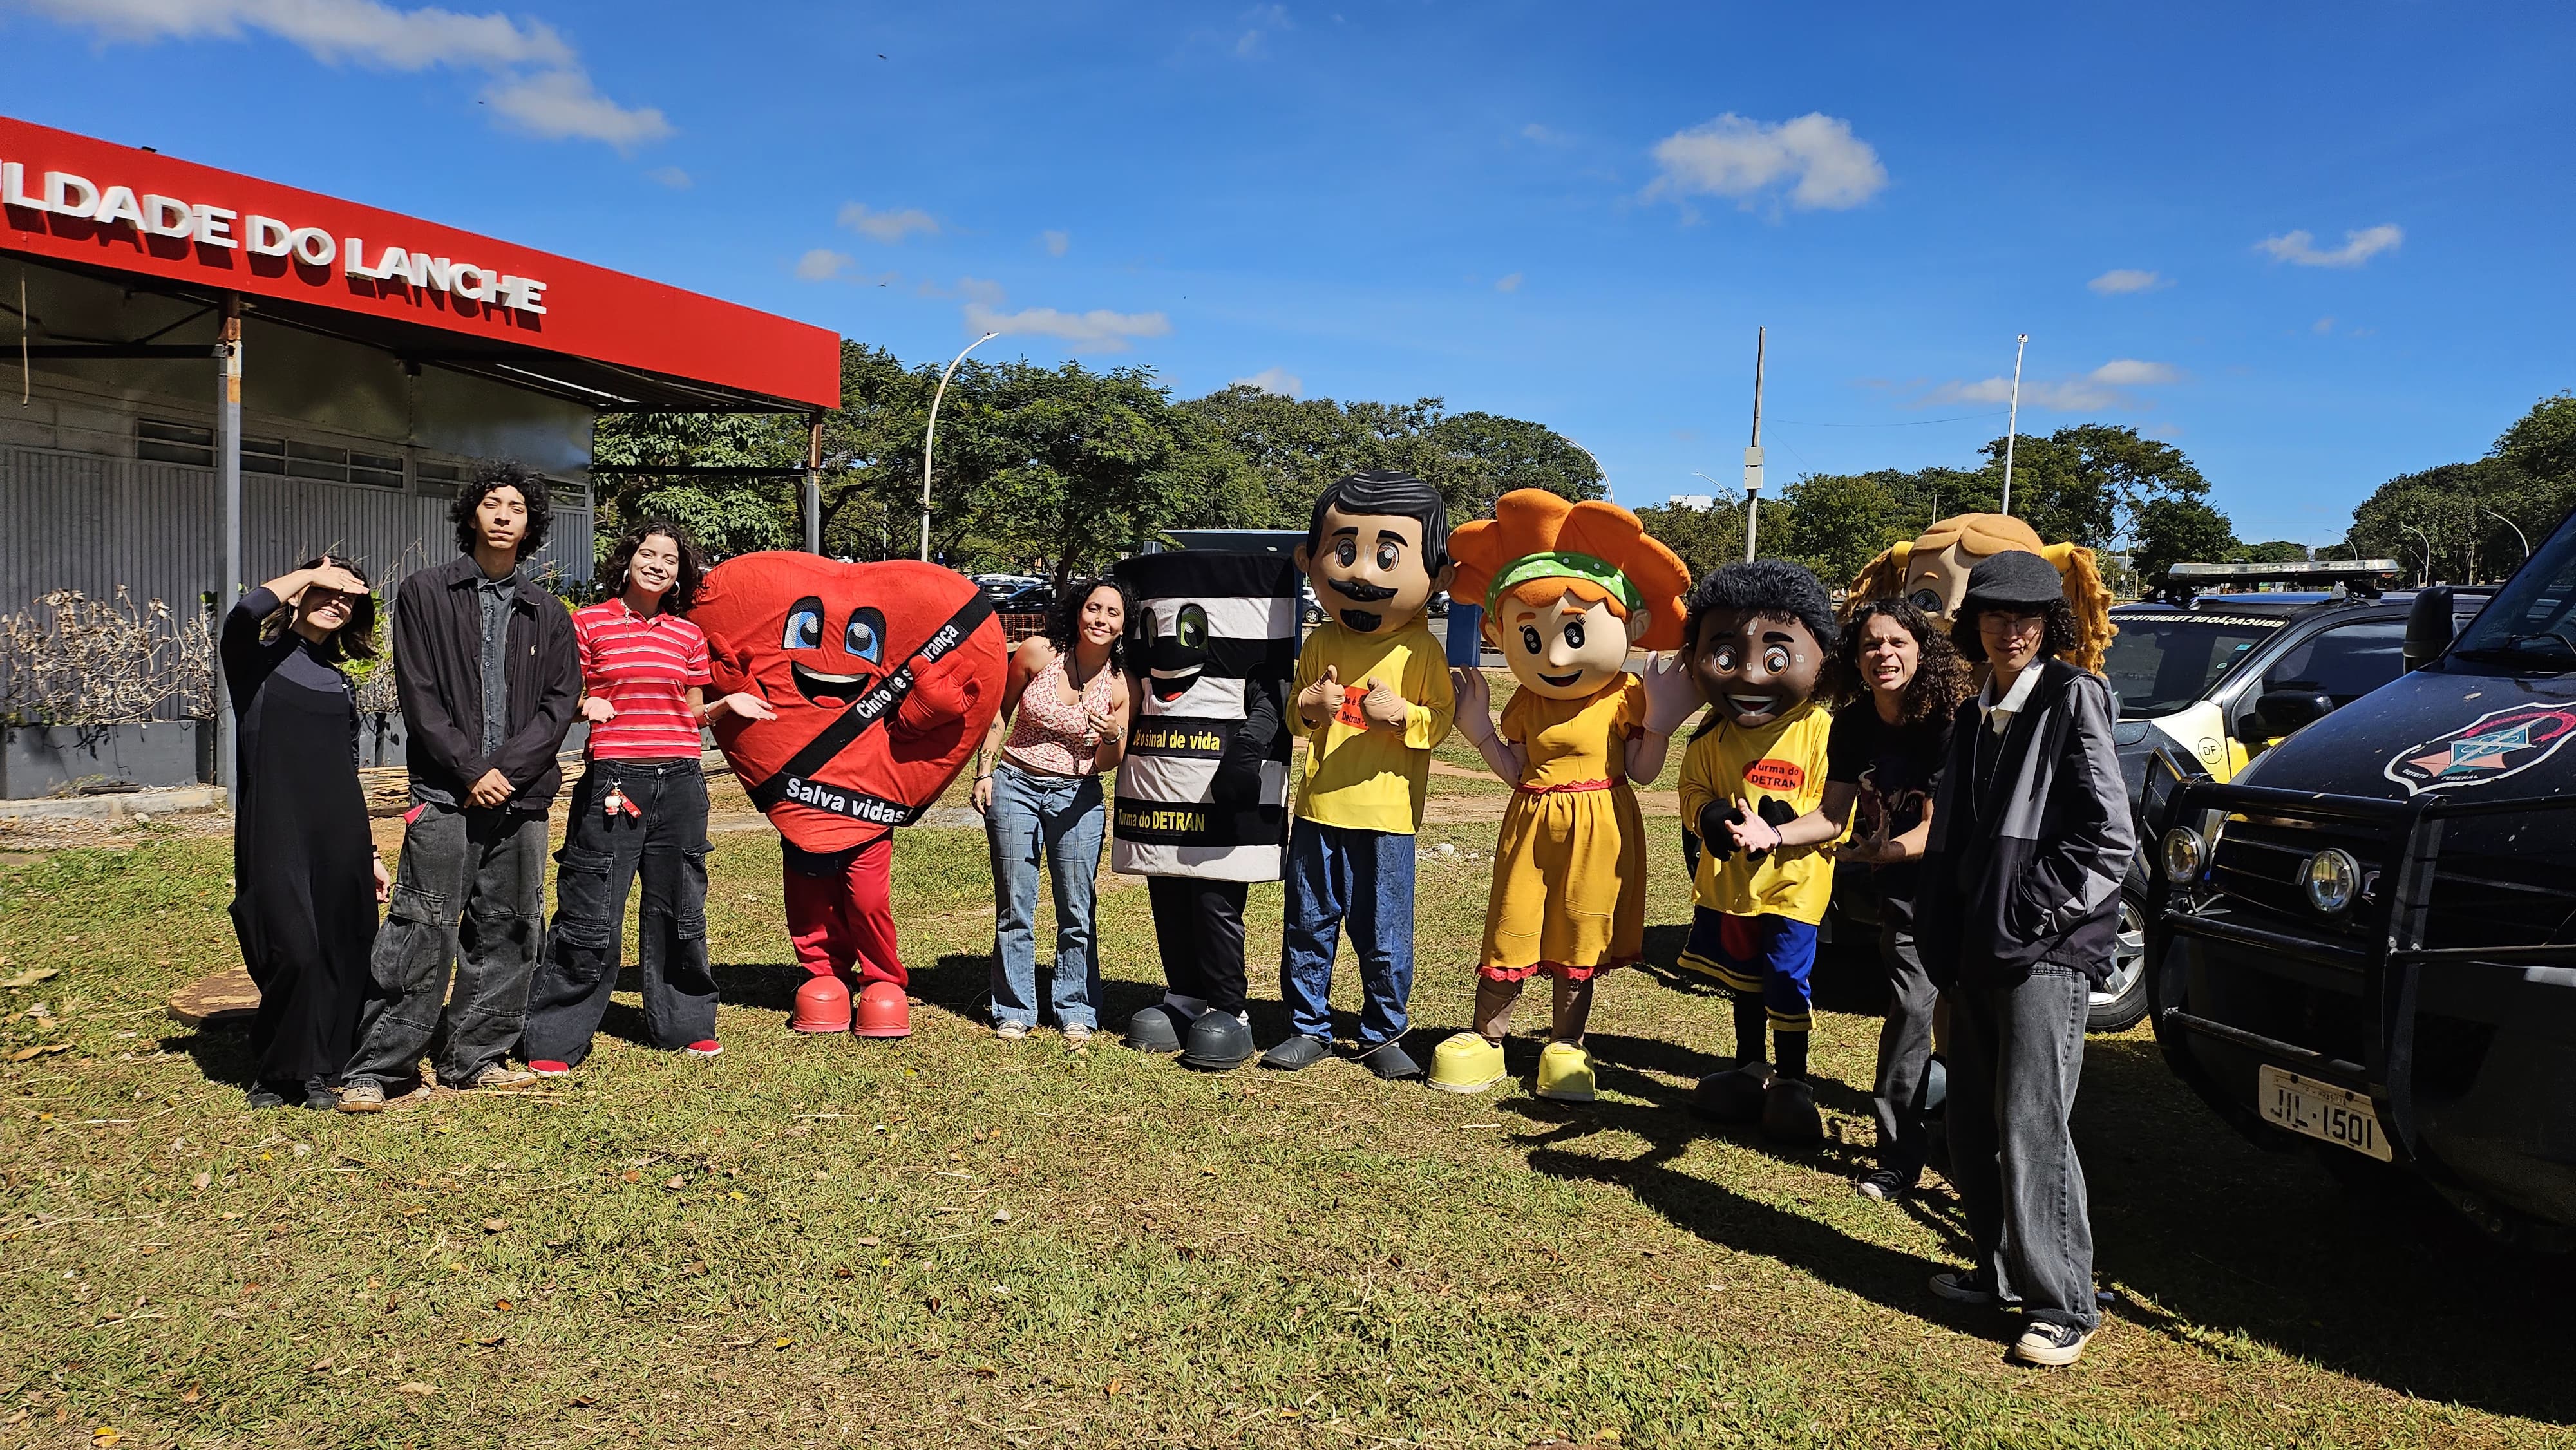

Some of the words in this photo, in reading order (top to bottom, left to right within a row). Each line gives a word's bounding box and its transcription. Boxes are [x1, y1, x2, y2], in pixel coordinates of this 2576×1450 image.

[0, 160, 238, 249] LDADE
[246, 215, 336, 266] DO
[345, 238, 547, 314] LANCHE
[857, 690, 892, 719] Cinto
[887, 677, 906, 693] de
[902, 625, 959, 681] srança
[1342, 711, 1361, 724] Detran
[1145, 729, 1166, 748] sinal
[1170, 730, 1186, 749] de
[1190, 731, 1220, 751] vida
[2203, 746, 2217, 755] DF
[1752, 761, 1785, 774] Turma
[1788, 767, 1799, 775] do
[1752, 775, 1796, 788] DETRAN
[786, 778, 846, 812] Salva
[852, 799, 913, 823] vidas!
[1119, 809, 1137, 827] Turma
[1139, 811, 1150, 828] do
[1152, 811, 1204, 831] DETRAN
